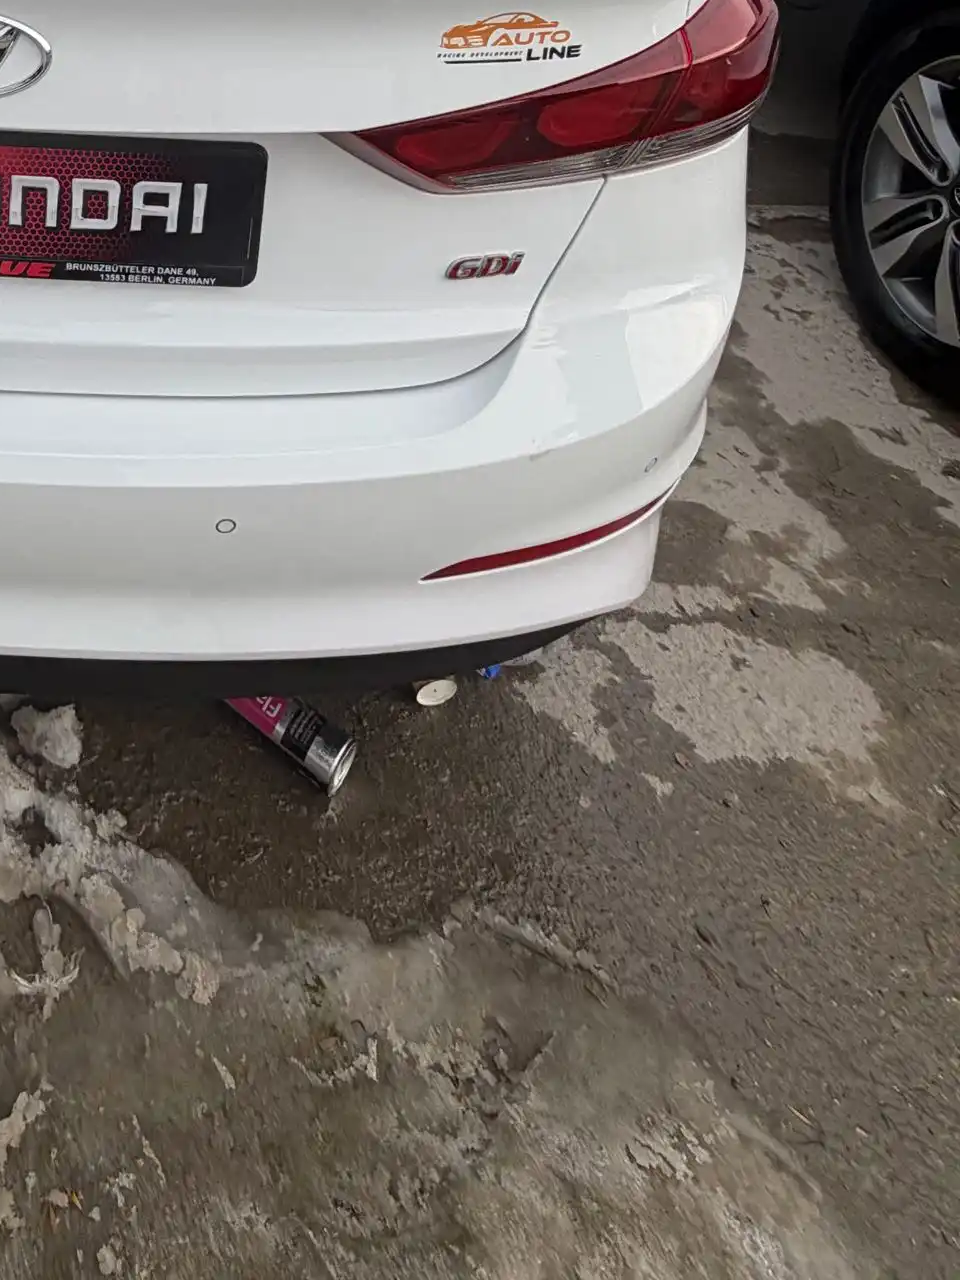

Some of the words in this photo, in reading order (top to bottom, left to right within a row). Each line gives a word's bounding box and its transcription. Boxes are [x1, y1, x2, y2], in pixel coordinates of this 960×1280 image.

[491, 30, 571, 47] AUTO
[526, 44, 583, 61] LINE
[157, 267, 183, 276] DANE
[168, 276, 217, 285] GERMANY
